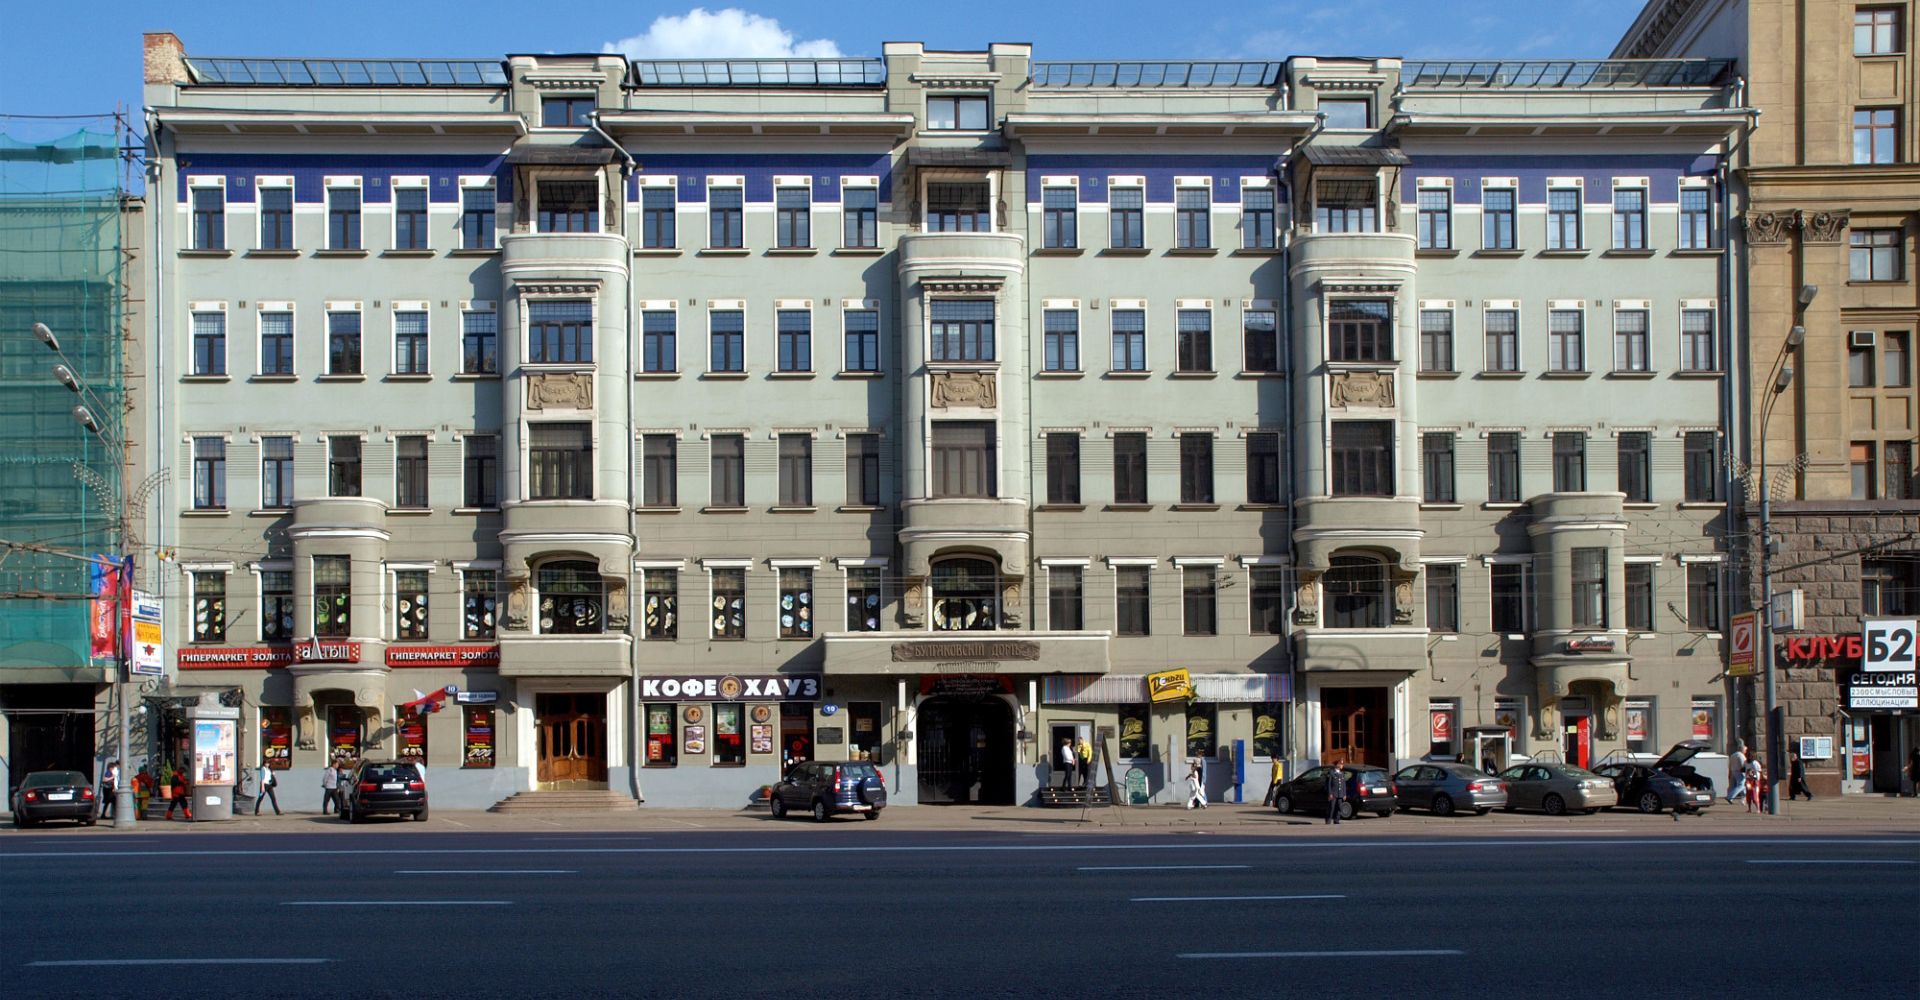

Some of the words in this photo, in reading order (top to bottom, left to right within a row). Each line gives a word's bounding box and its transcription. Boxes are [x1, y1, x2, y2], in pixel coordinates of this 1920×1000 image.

[1788, 636, 1864, 659] КЛУБ
[1867, 628, 1913, 662] Б2
[180, 652, 248, 662] ГИПЕРМАРКЕТ
[252, 652, 292, 662] ЗОЛОТА
[390, 651, 457, 660] ГИПЕРМАРКЕТ
[461, 651, 499, 660] ЗОЛОТА
[642, 678, 717, 697] КОФЕ
[743, 679, 818, 697] ХАУЗ
[1851, 673, 1916, 686] СЕГОДНЯ
